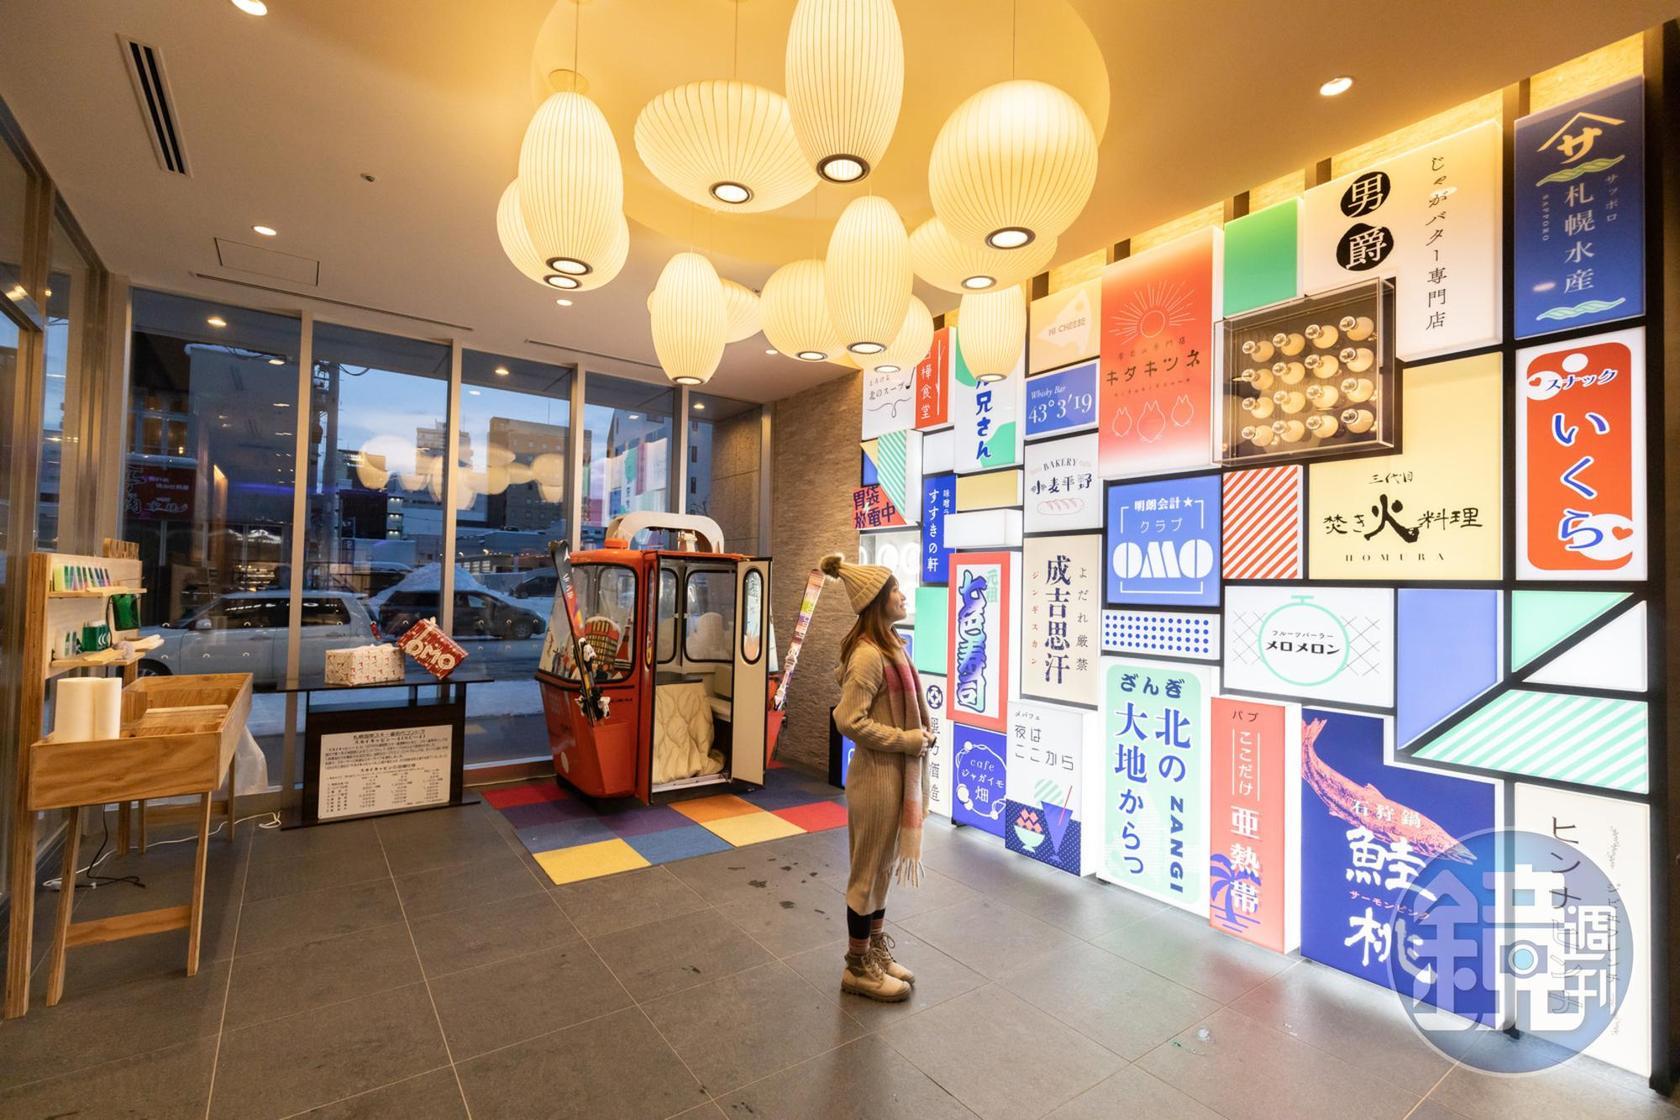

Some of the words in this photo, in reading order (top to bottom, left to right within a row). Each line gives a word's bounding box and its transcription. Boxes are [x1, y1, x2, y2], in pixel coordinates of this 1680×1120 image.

[1606, 173, 1618, 223] サッポロ
[1346, 173, 1388, 269] 男爵
[1425, 156, 1448, 331] じゃがバター専門店
[1563, 183, 1597, 294] 札幌水産
[1106, 349, 1200, 386] キタキツネ
[1545, 367, 1617, 394] スナック
[1042, 457, 1076, 471] BAKERY
[1368, 470, 1415, 486] 三代目
[1551, 410, 1611, 551] いくら
[1031, 473, 1093, 496] 小麦平野
[1134, 496, 1181, 512] 明朗会計
[1323, 493, 1483, 543] 焚き火料理
[927, 488, 940, 573] すすきの軒
[1139, 517, 1183, 533] クラブ
[1112, 539, 1214, 580] OMO
[1345, 551, 1446, 564] HOMURA
[1031, 571, 1040, 665] ジンギスカン
[1044, 554, 1072, 685] 成吉思汗
[1076, 567, 1089, 672] よだれ厳禁
[404, 639, 457, 670] OMO
[1266, 640, 1341, 656] メロメロン
[1119, 672, 1185, 698] ざんぎ
[1014, 723, 1042, 743] 夜は
[1154, 707, 1192, 784] 北の
[970, 758, 995, 773] cafe
[1014, 743, 1075, 771] ここから
[1237, 730, 1255, 797] ここだけ
[961, 768, 1005, 789] ジャガイモ
[975, 786, 989, 803] 畑
[1352, 798, 1421, 830] 石狩鍋
[1169, 795, 1184, 893] ZANGI
[1229, 804, 1262, 915] 亜熱帯
[1344, 824, 1437, 901] 鮭
[1349, 889, 1431, 921] サーモンピンク
